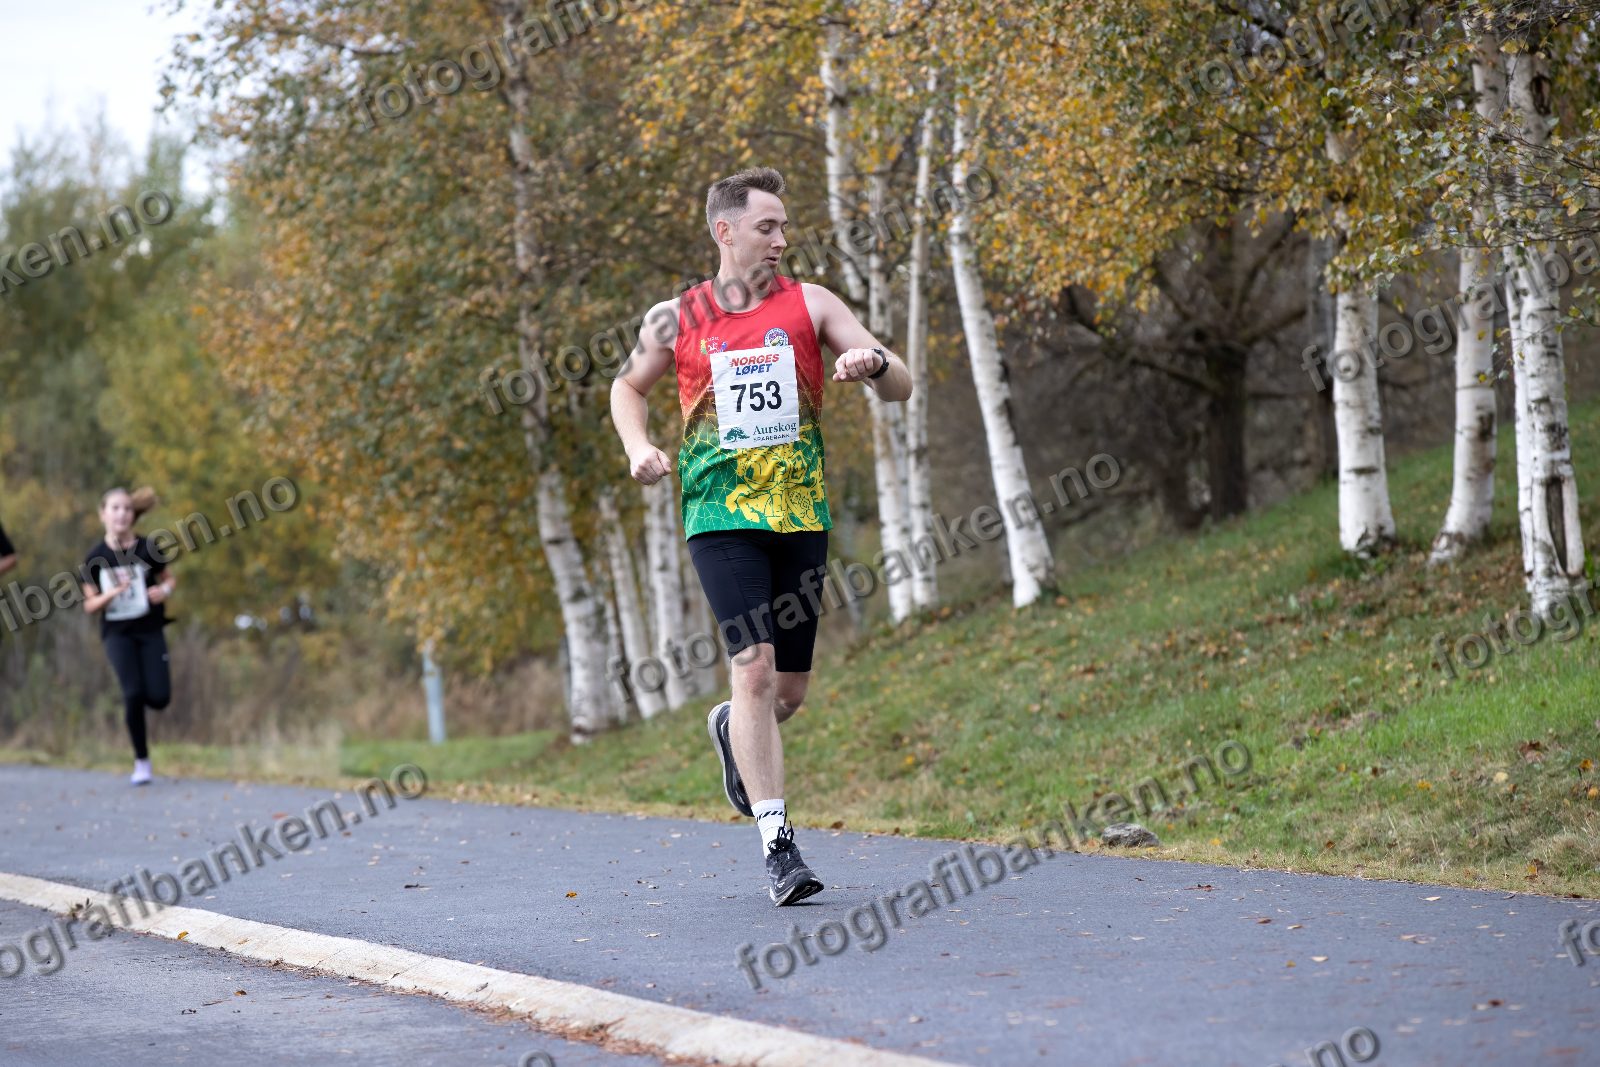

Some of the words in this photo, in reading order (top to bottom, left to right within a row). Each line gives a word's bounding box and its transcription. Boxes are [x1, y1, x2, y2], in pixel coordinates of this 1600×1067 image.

[731, 354, 780, 367] NORGES
[735, 363, 772, 376] LØPET
[730, 380, 782, 412] 753
[753, 422, 797, 435] Aurskog
